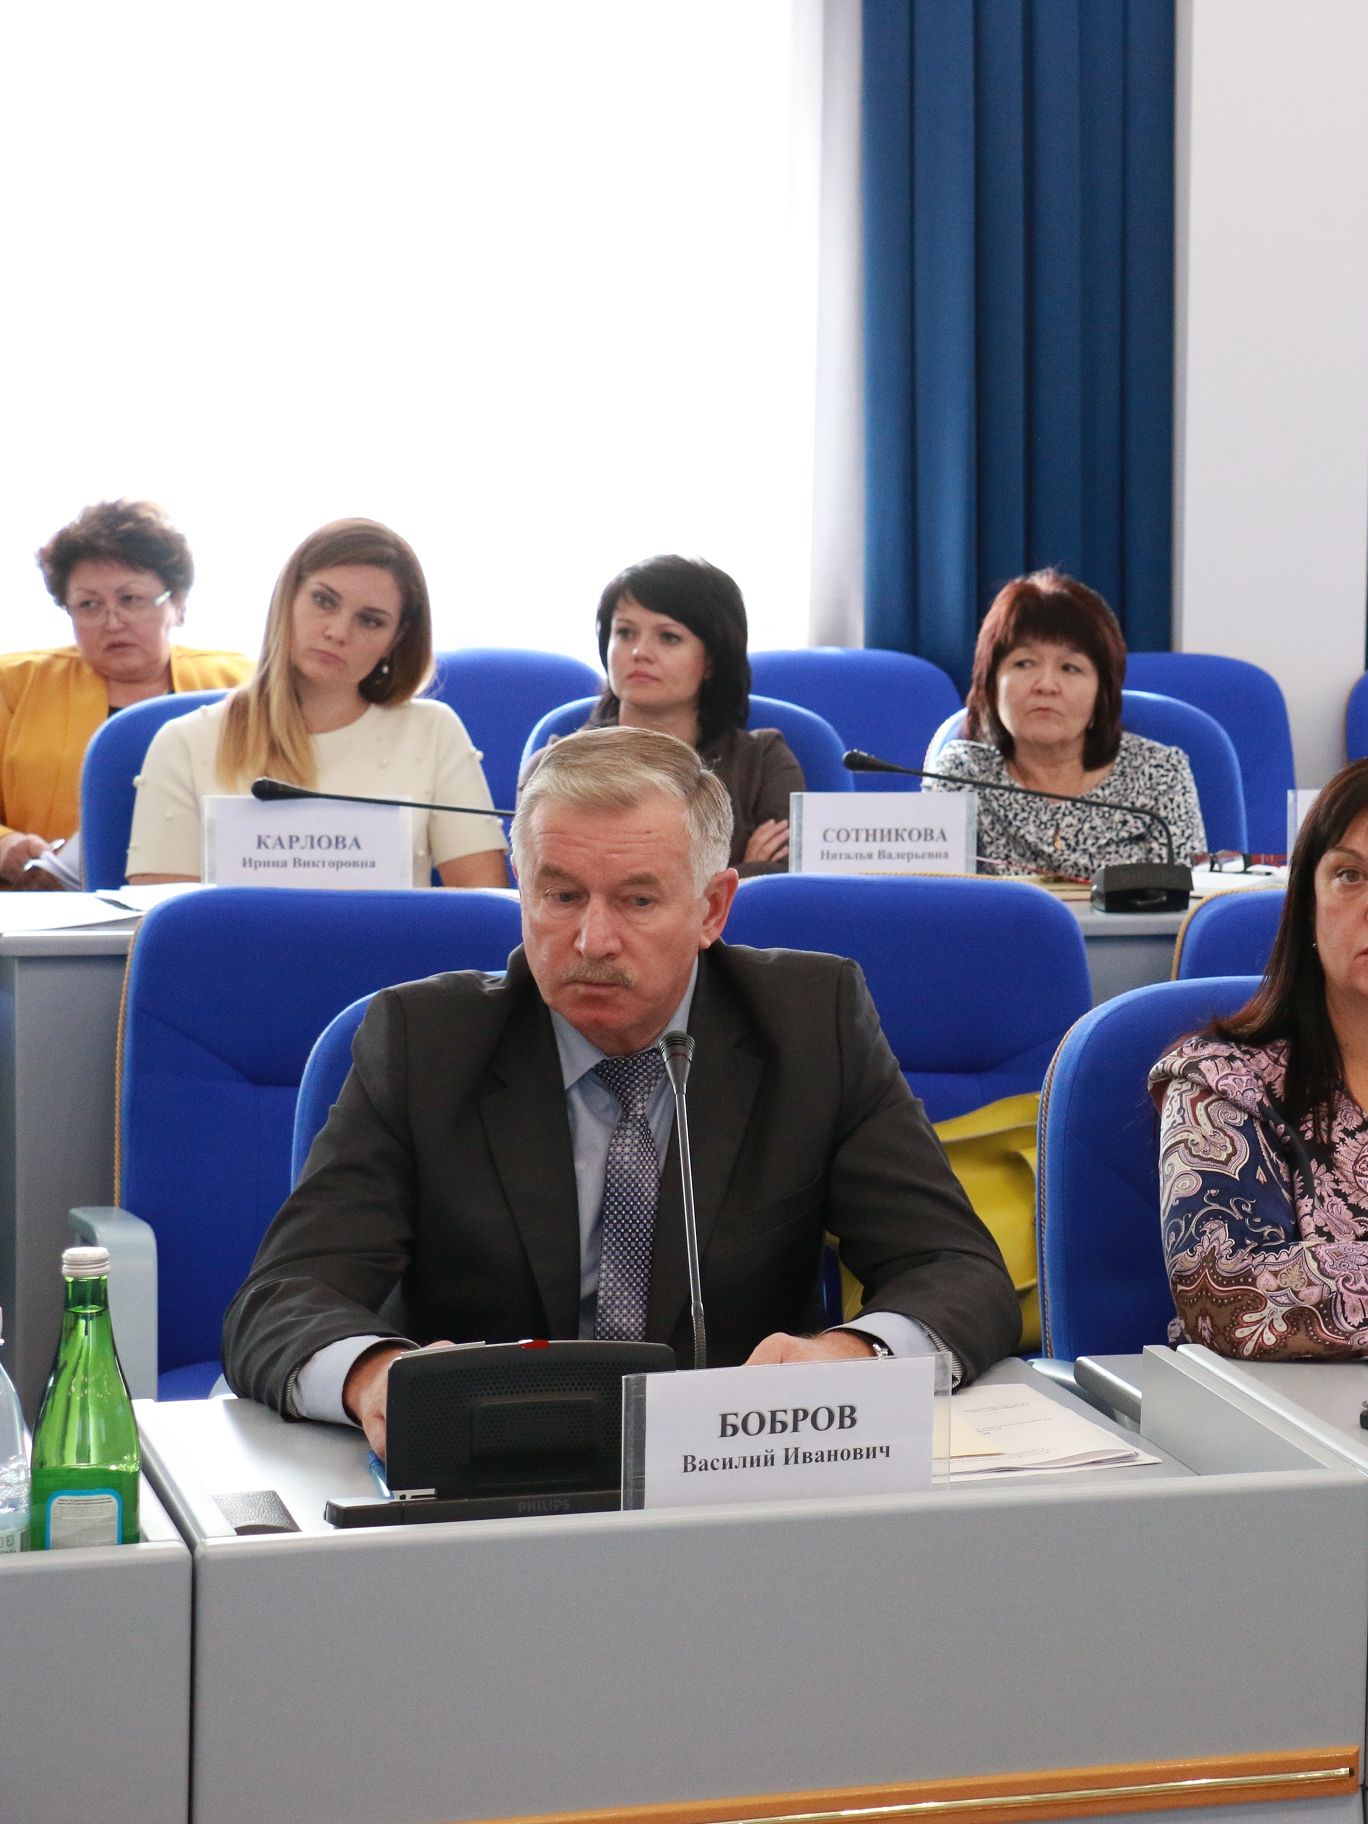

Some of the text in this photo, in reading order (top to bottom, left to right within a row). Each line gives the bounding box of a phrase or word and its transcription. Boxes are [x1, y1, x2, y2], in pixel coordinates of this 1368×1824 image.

[256, 834, 362, 851] КАРЛОВА
[822, 827, 948, 844] СОТНИКОВА
[242, 857, 376, 872] Ирина Викторовна
[820, 849, 949, 863] Наталья Валерьевна
[718, 1404, 858, 1439] БОБРОВ
[681, 1443, 892, 1474] Василий Иванович
[517, 1498, 571, 1513] PHILIPS
